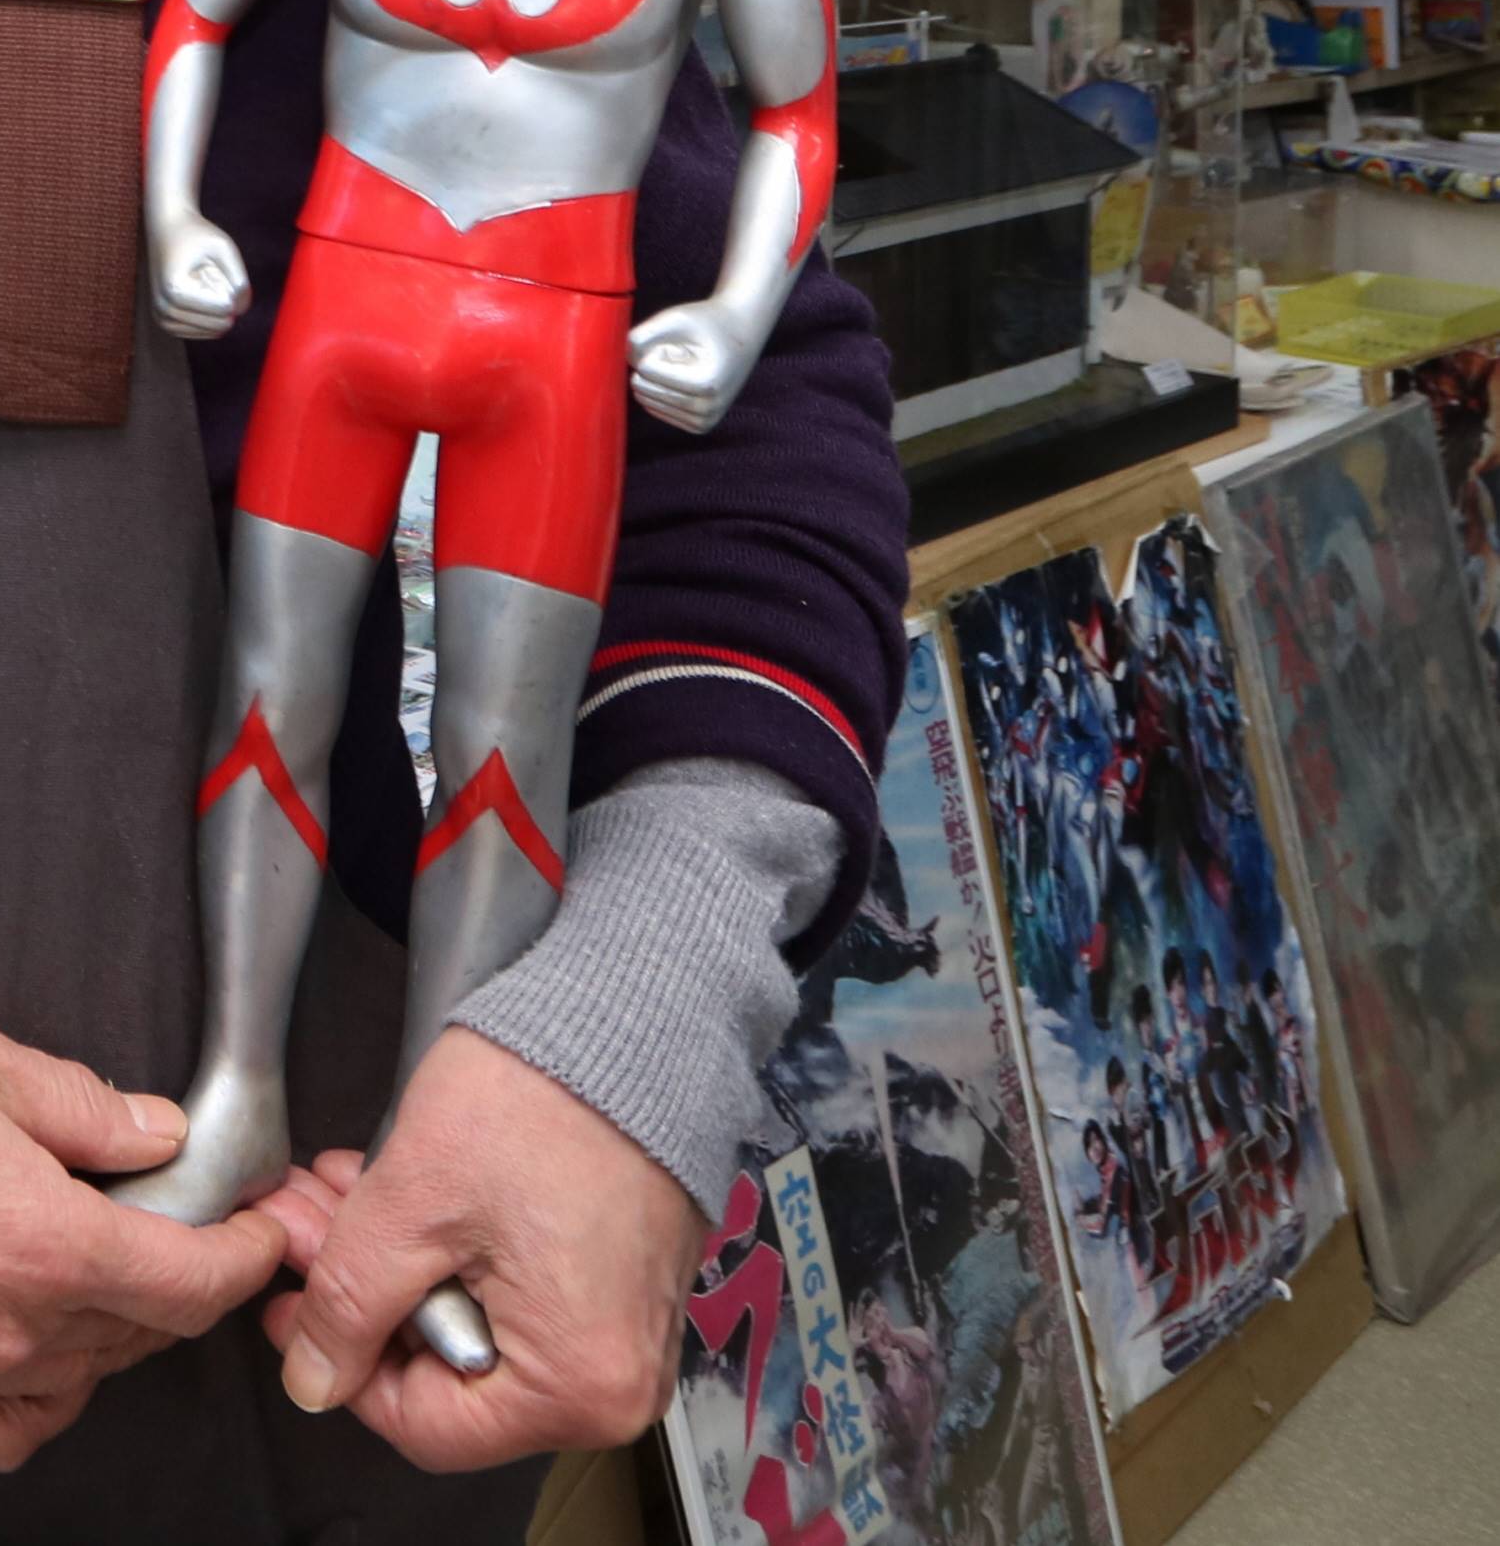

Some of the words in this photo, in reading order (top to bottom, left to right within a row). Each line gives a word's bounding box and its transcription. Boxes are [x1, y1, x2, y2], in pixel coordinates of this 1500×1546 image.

[777, 1169, 885, 1534] 空の大怪獣
